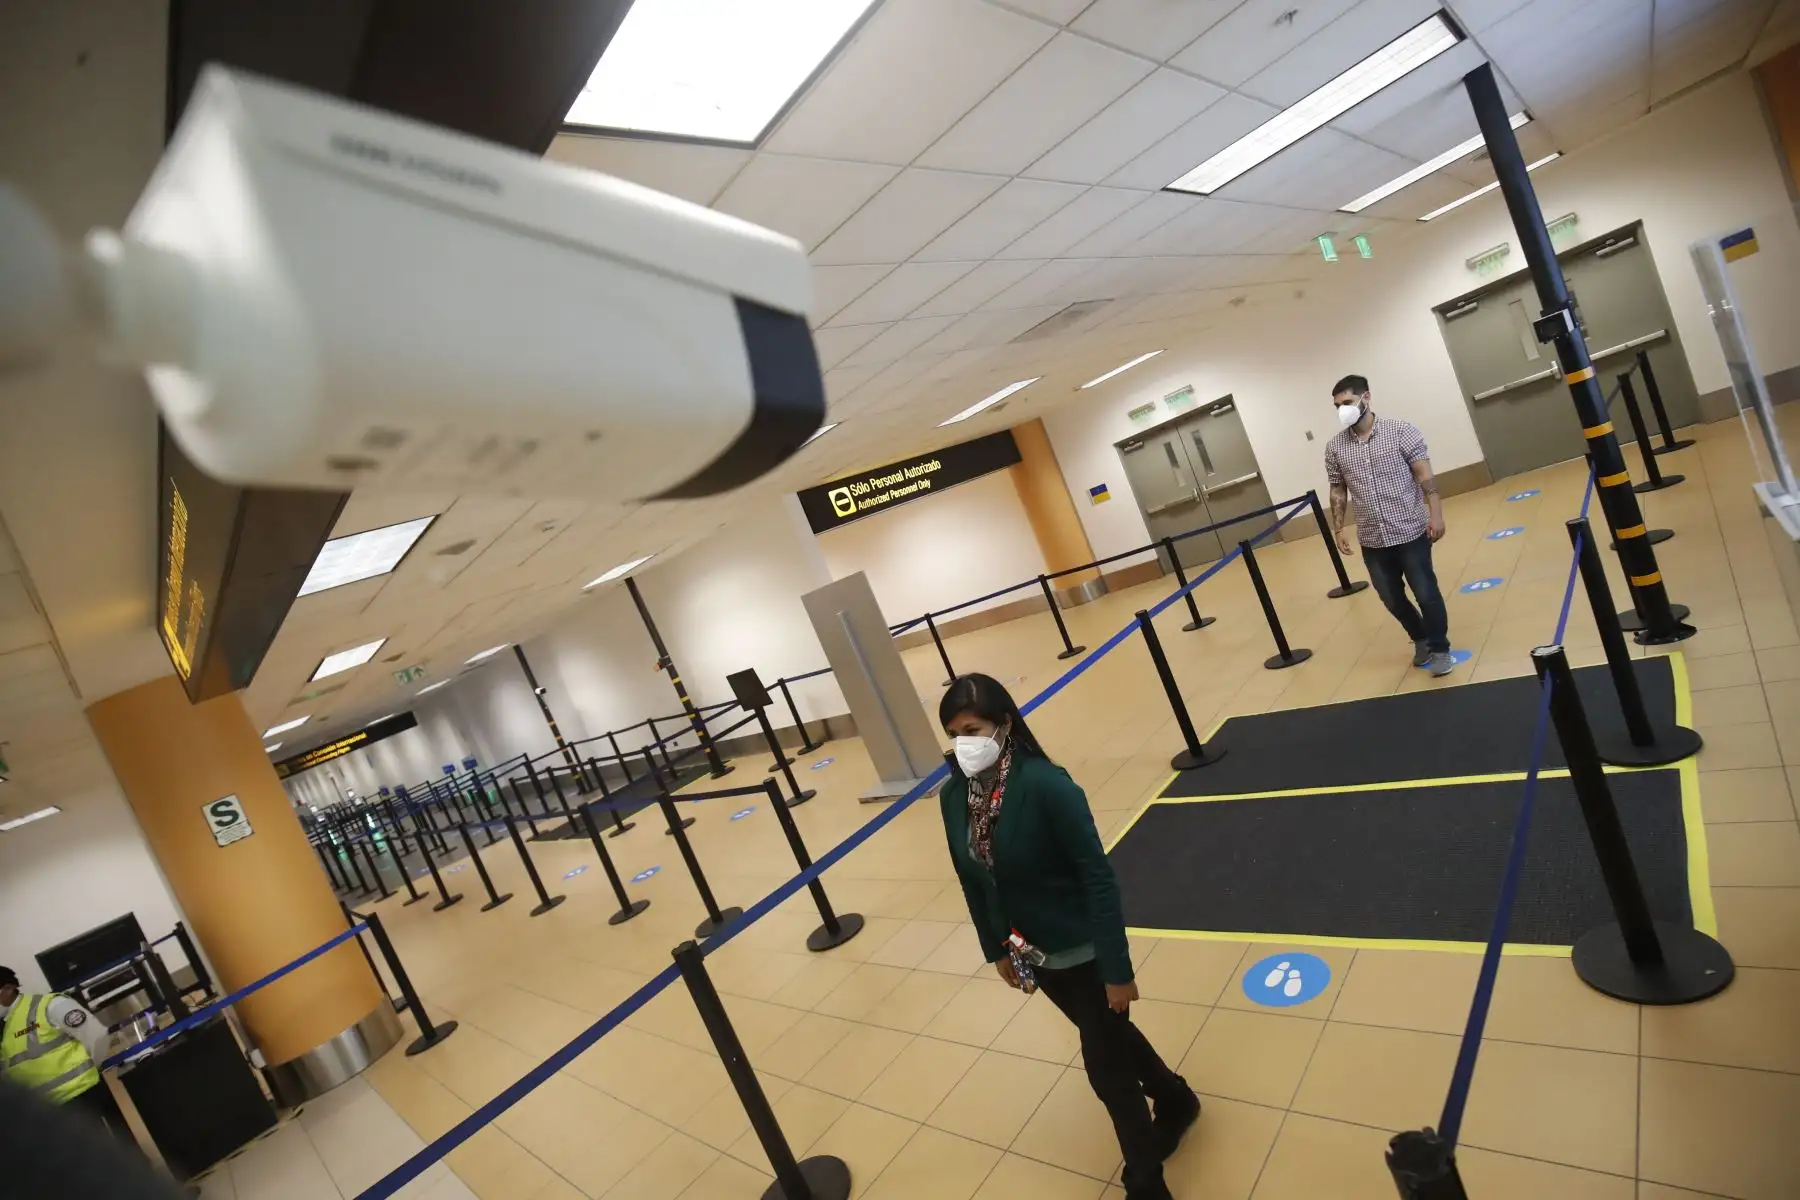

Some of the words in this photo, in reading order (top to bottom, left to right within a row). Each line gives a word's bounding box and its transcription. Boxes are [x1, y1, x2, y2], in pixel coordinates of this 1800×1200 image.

[850, 483, 870, 497] Sólo
[870, 470, 904, 490] Personal
[904, 459, 941, 479] Autorizado
[858, 492, 890, 510] Authorized
[890, 483, 918, 500] Personnel
[918, 479, 931, 489] Only
[210, 800, 239, 827] S
